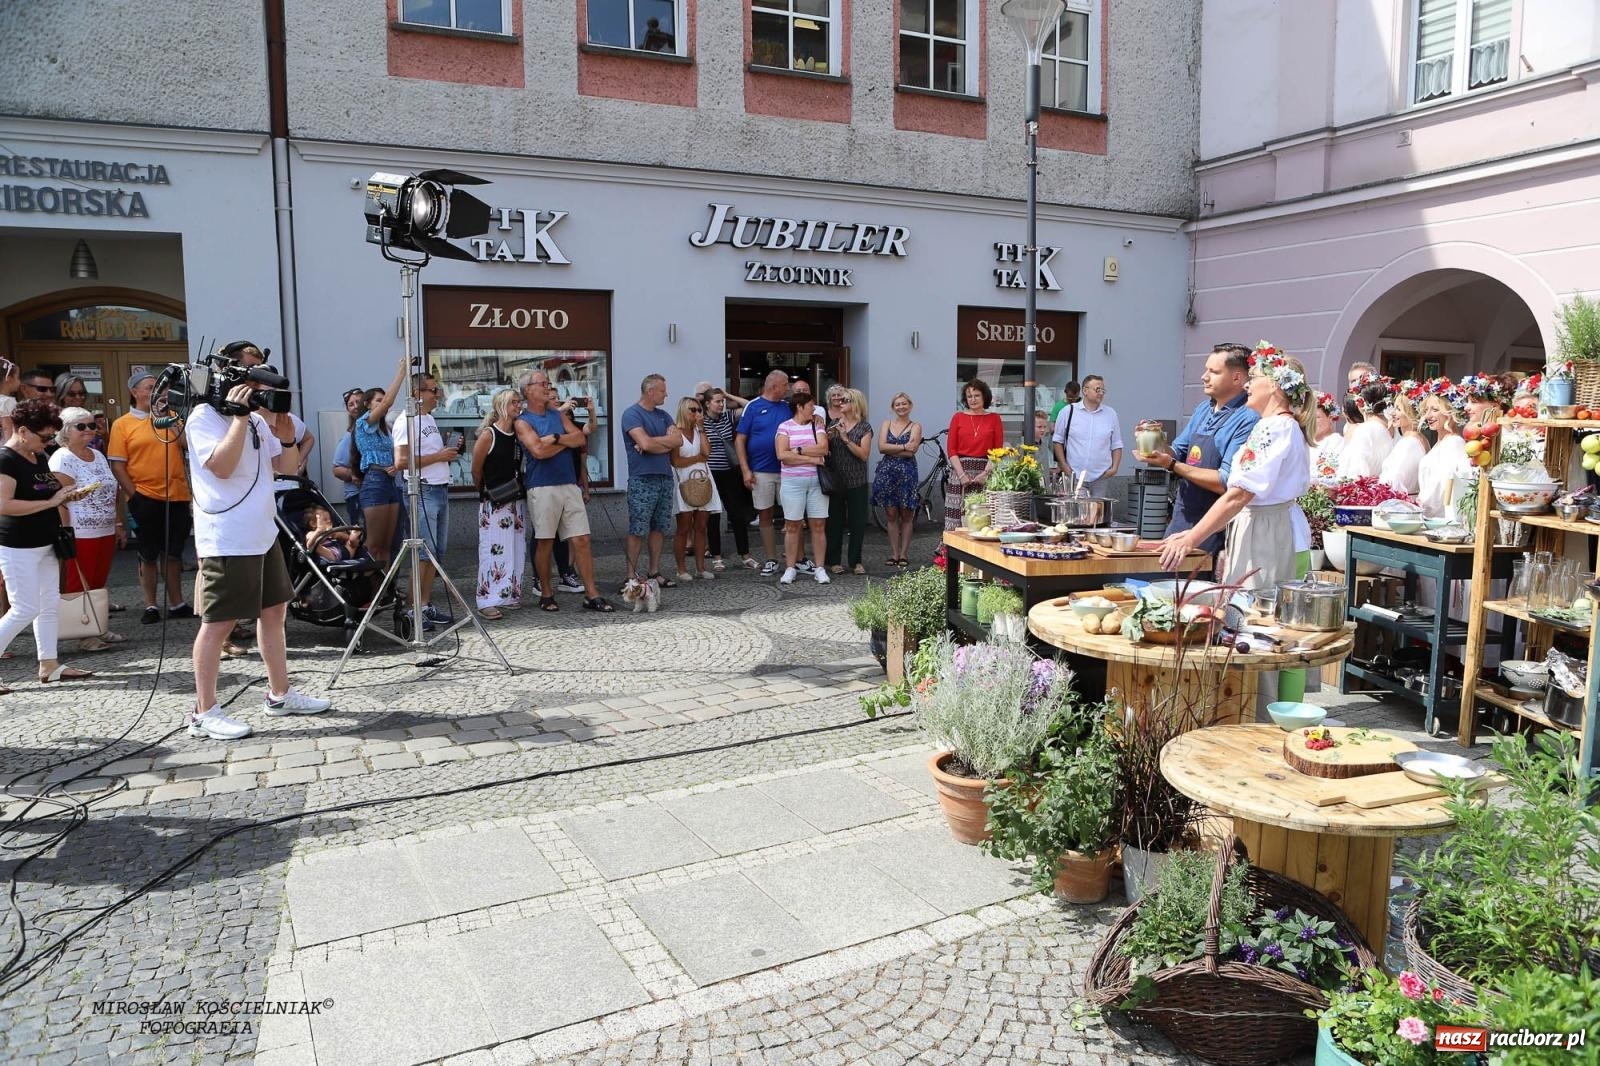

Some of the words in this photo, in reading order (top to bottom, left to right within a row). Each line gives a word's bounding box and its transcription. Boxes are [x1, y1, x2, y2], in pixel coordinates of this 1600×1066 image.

[0, 155, 171, 186] RESTAURACJA
[0, 184, 150, 218] IBORSKA
[689, 203, 912, 257] JUBILER
[744, 260, 855, 287] ZŁOTNIK
[468, 303, 570, 330] ZŁOTO
